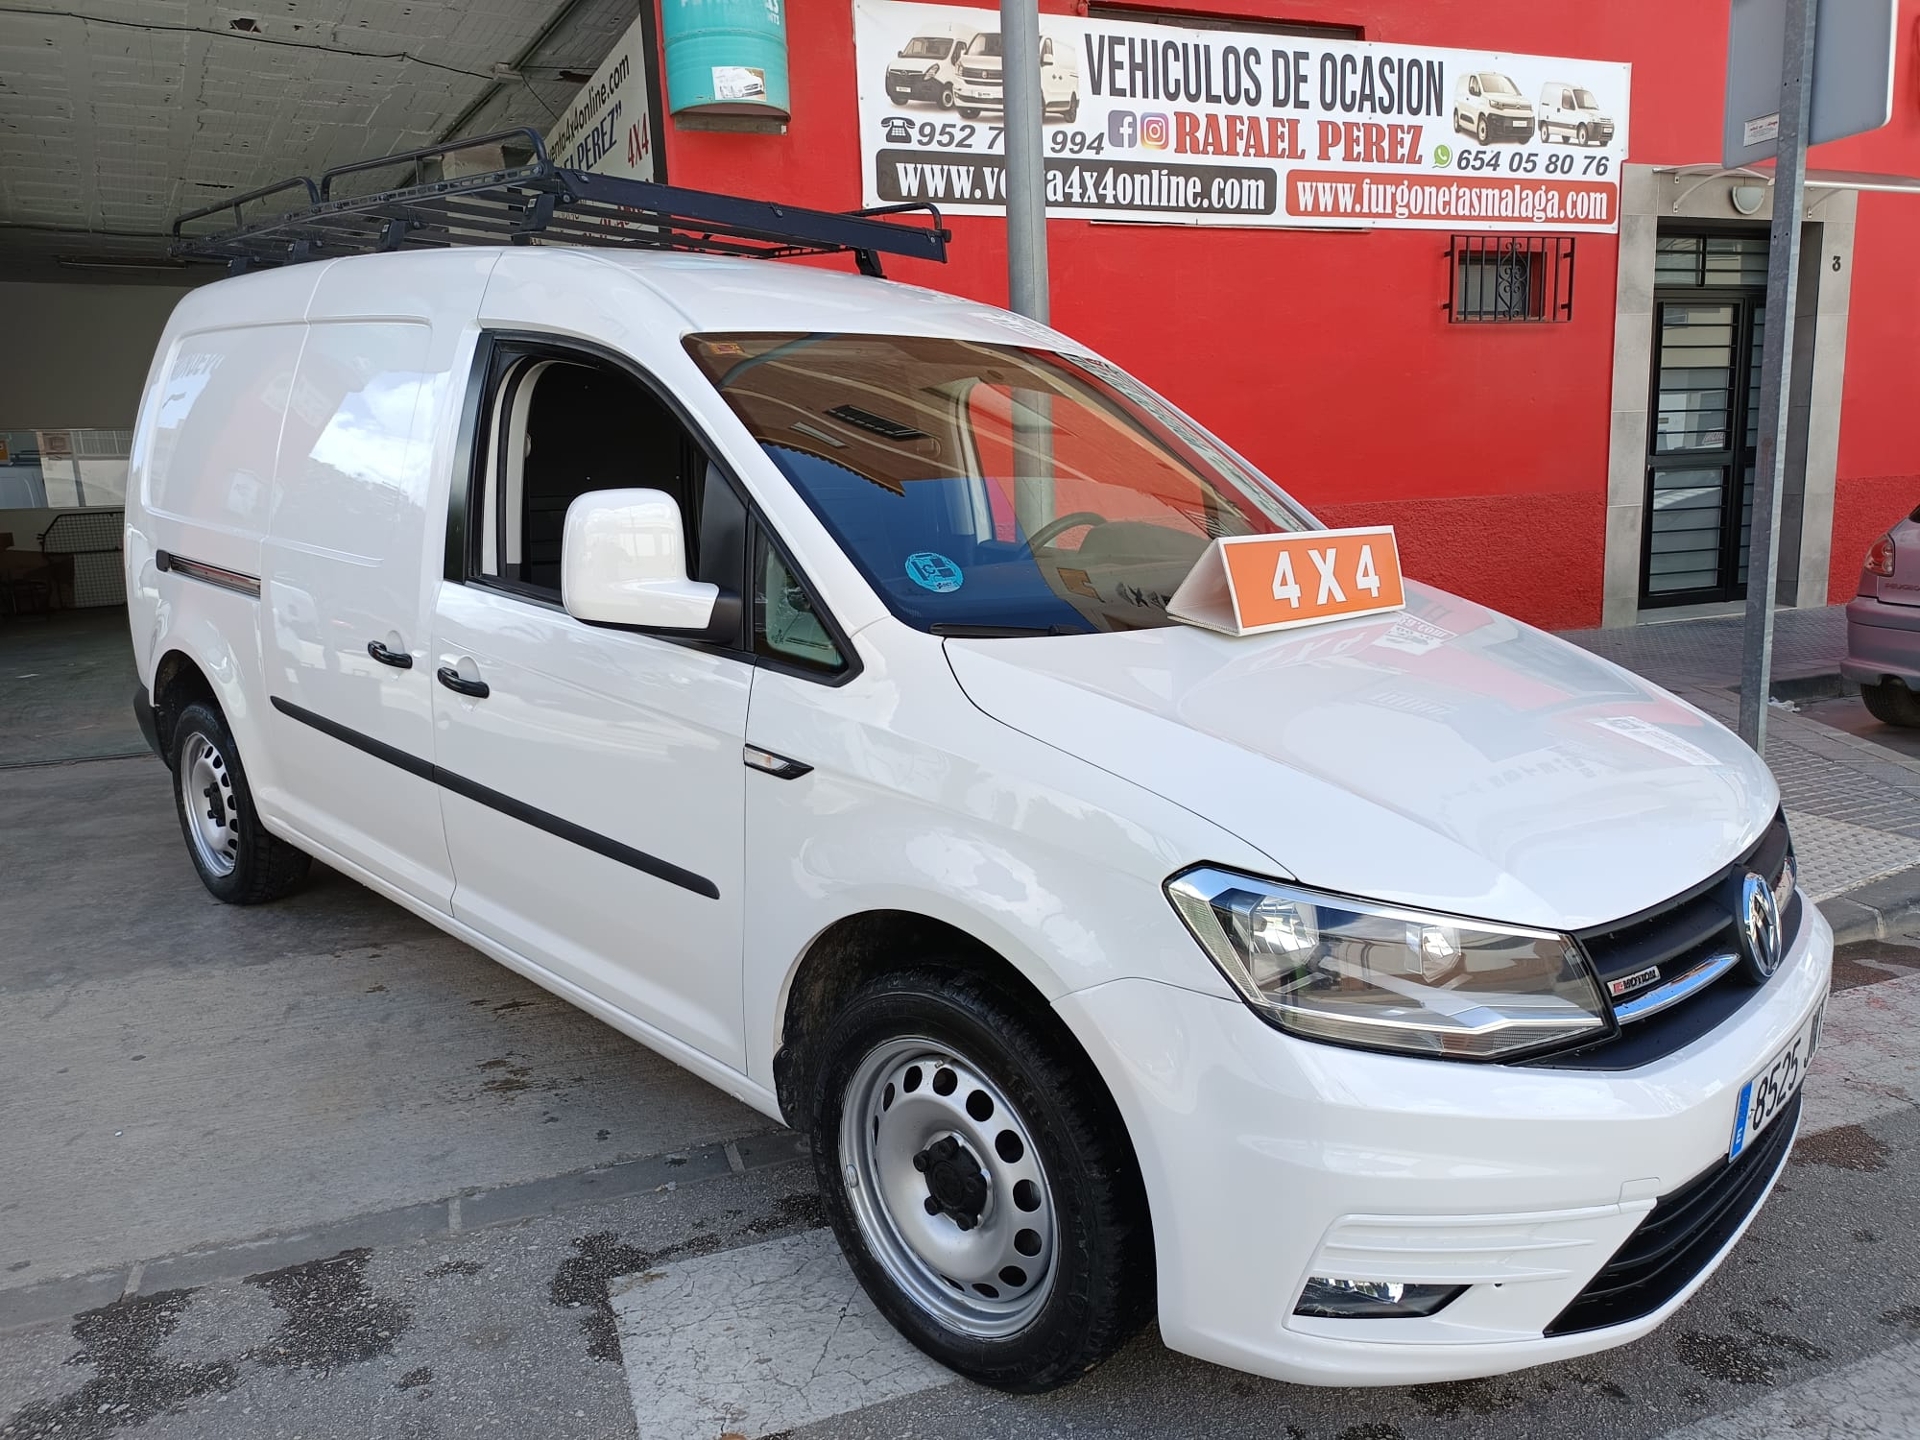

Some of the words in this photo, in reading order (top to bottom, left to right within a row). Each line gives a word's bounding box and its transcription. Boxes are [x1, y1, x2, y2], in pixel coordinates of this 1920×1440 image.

[1085, 33, 1261, 107] VEHICULOS
[1272, 49, 1309, 110] DE
[1319, 52, 1444, 117] OCASION
[917, 121, 974, 149] 952
[1050, 130, 1105, 155] 994
[1174, 111, 1306, 161] RAFAEL
[1317, 120, 1422, 164] PEREZ
[1456, 149, 1501, 172] 654
[1508, 152, 1538, 174] 05
[1545, 154, 1574, 175] 80
[1582, 155, 1609, 176] 76
[1297, 178, 1608, 223] www.furgonetasmalaga.com
[1832, 256, 1841, 272] 3
[1753, 1037, 1801, 1130] 8525
